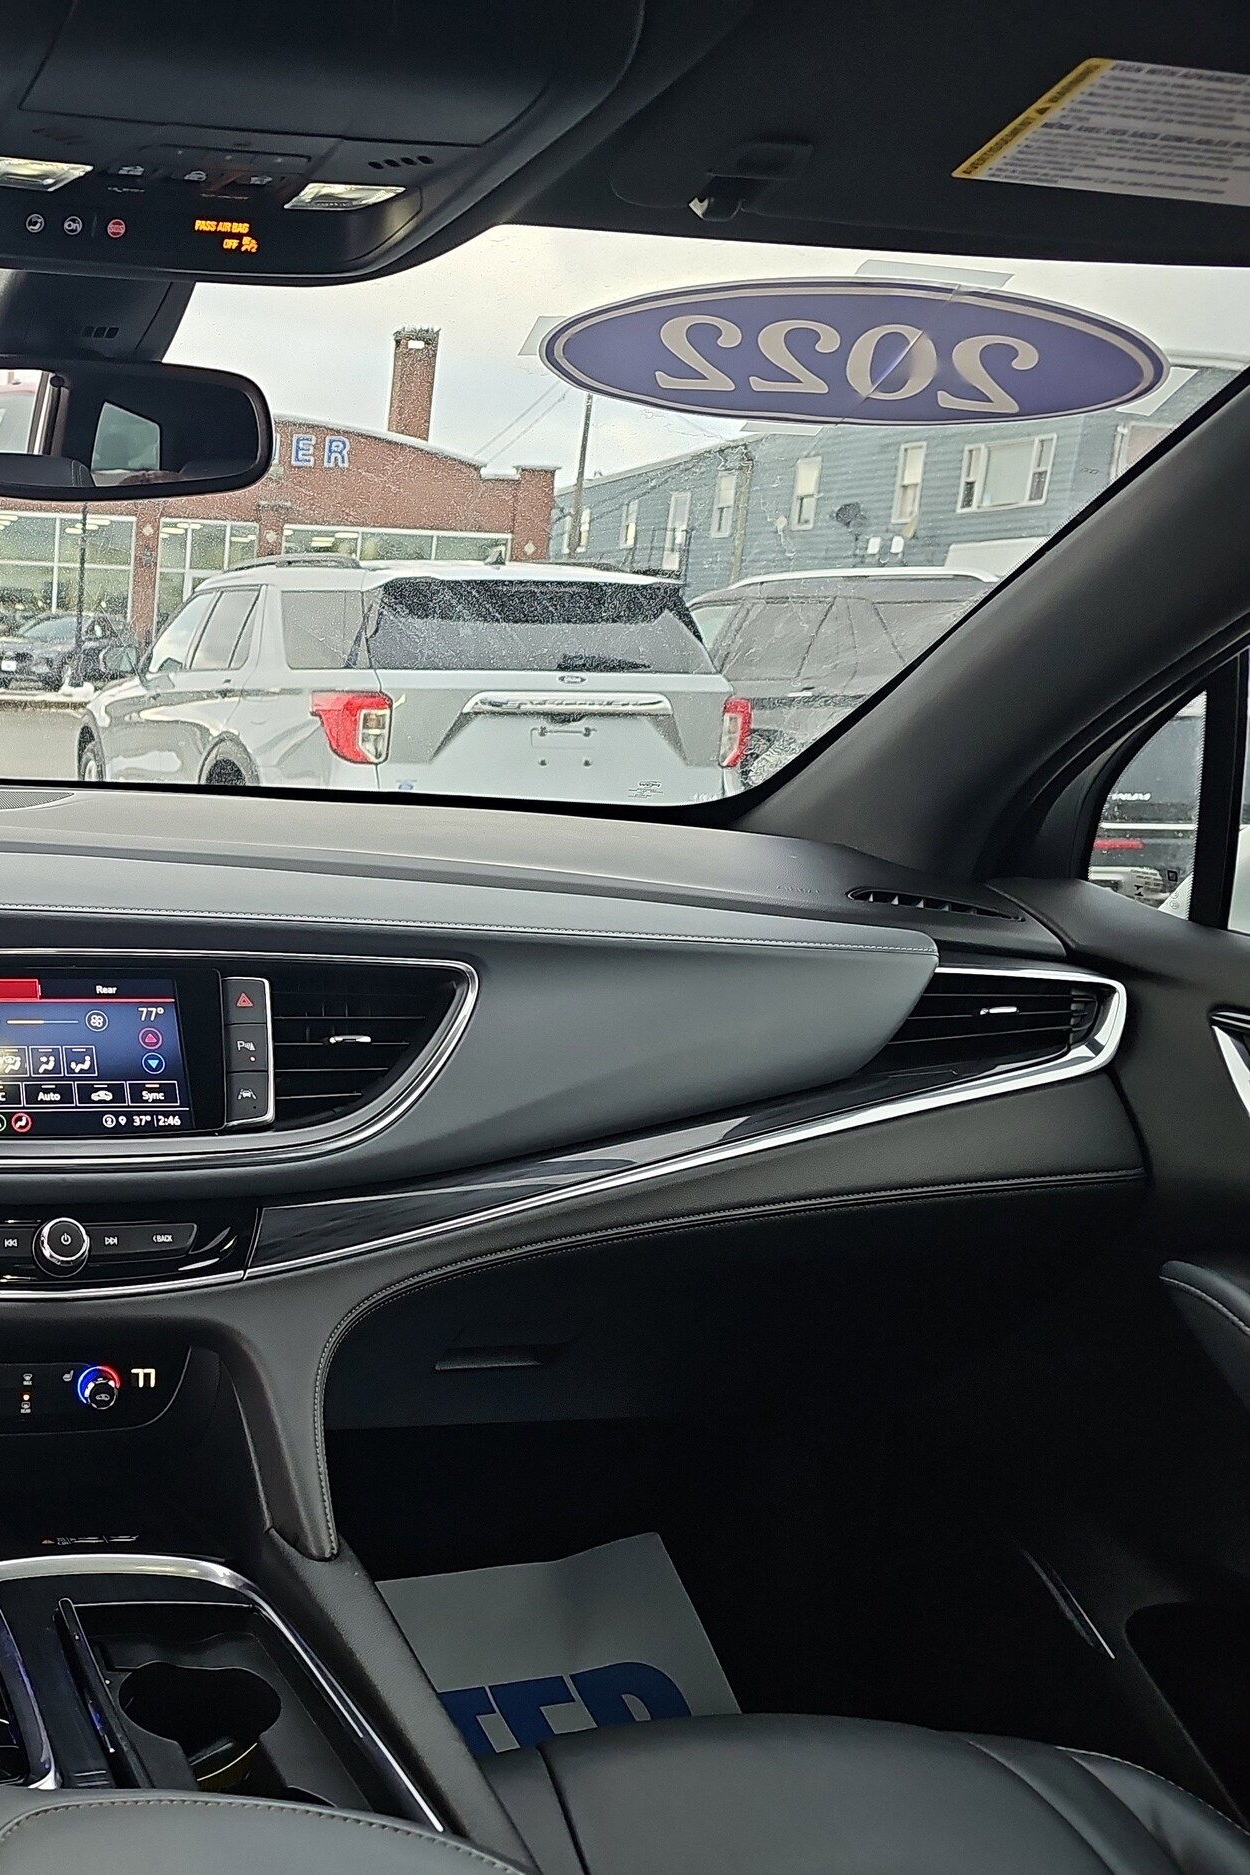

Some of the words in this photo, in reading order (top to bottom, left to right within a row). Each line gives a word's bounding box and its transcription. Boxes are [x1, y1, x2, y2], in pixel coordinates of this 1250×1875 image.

[195, 219, 217, 231] PASS
[217, 221, 232, 232] AIR
[232, 222, 250, 233] BAG
[223, 238, 240, 249] OFF
[275, 433, 350, 468] ER
[95, 985, 118, 995] Rear
[37, 1092, 61, 1101] Auto
[141, 1091, 165, 1103] Sync
[158, 1115, 181, 1126] 2:46
[156, 1234, 173, 1243] BACK
